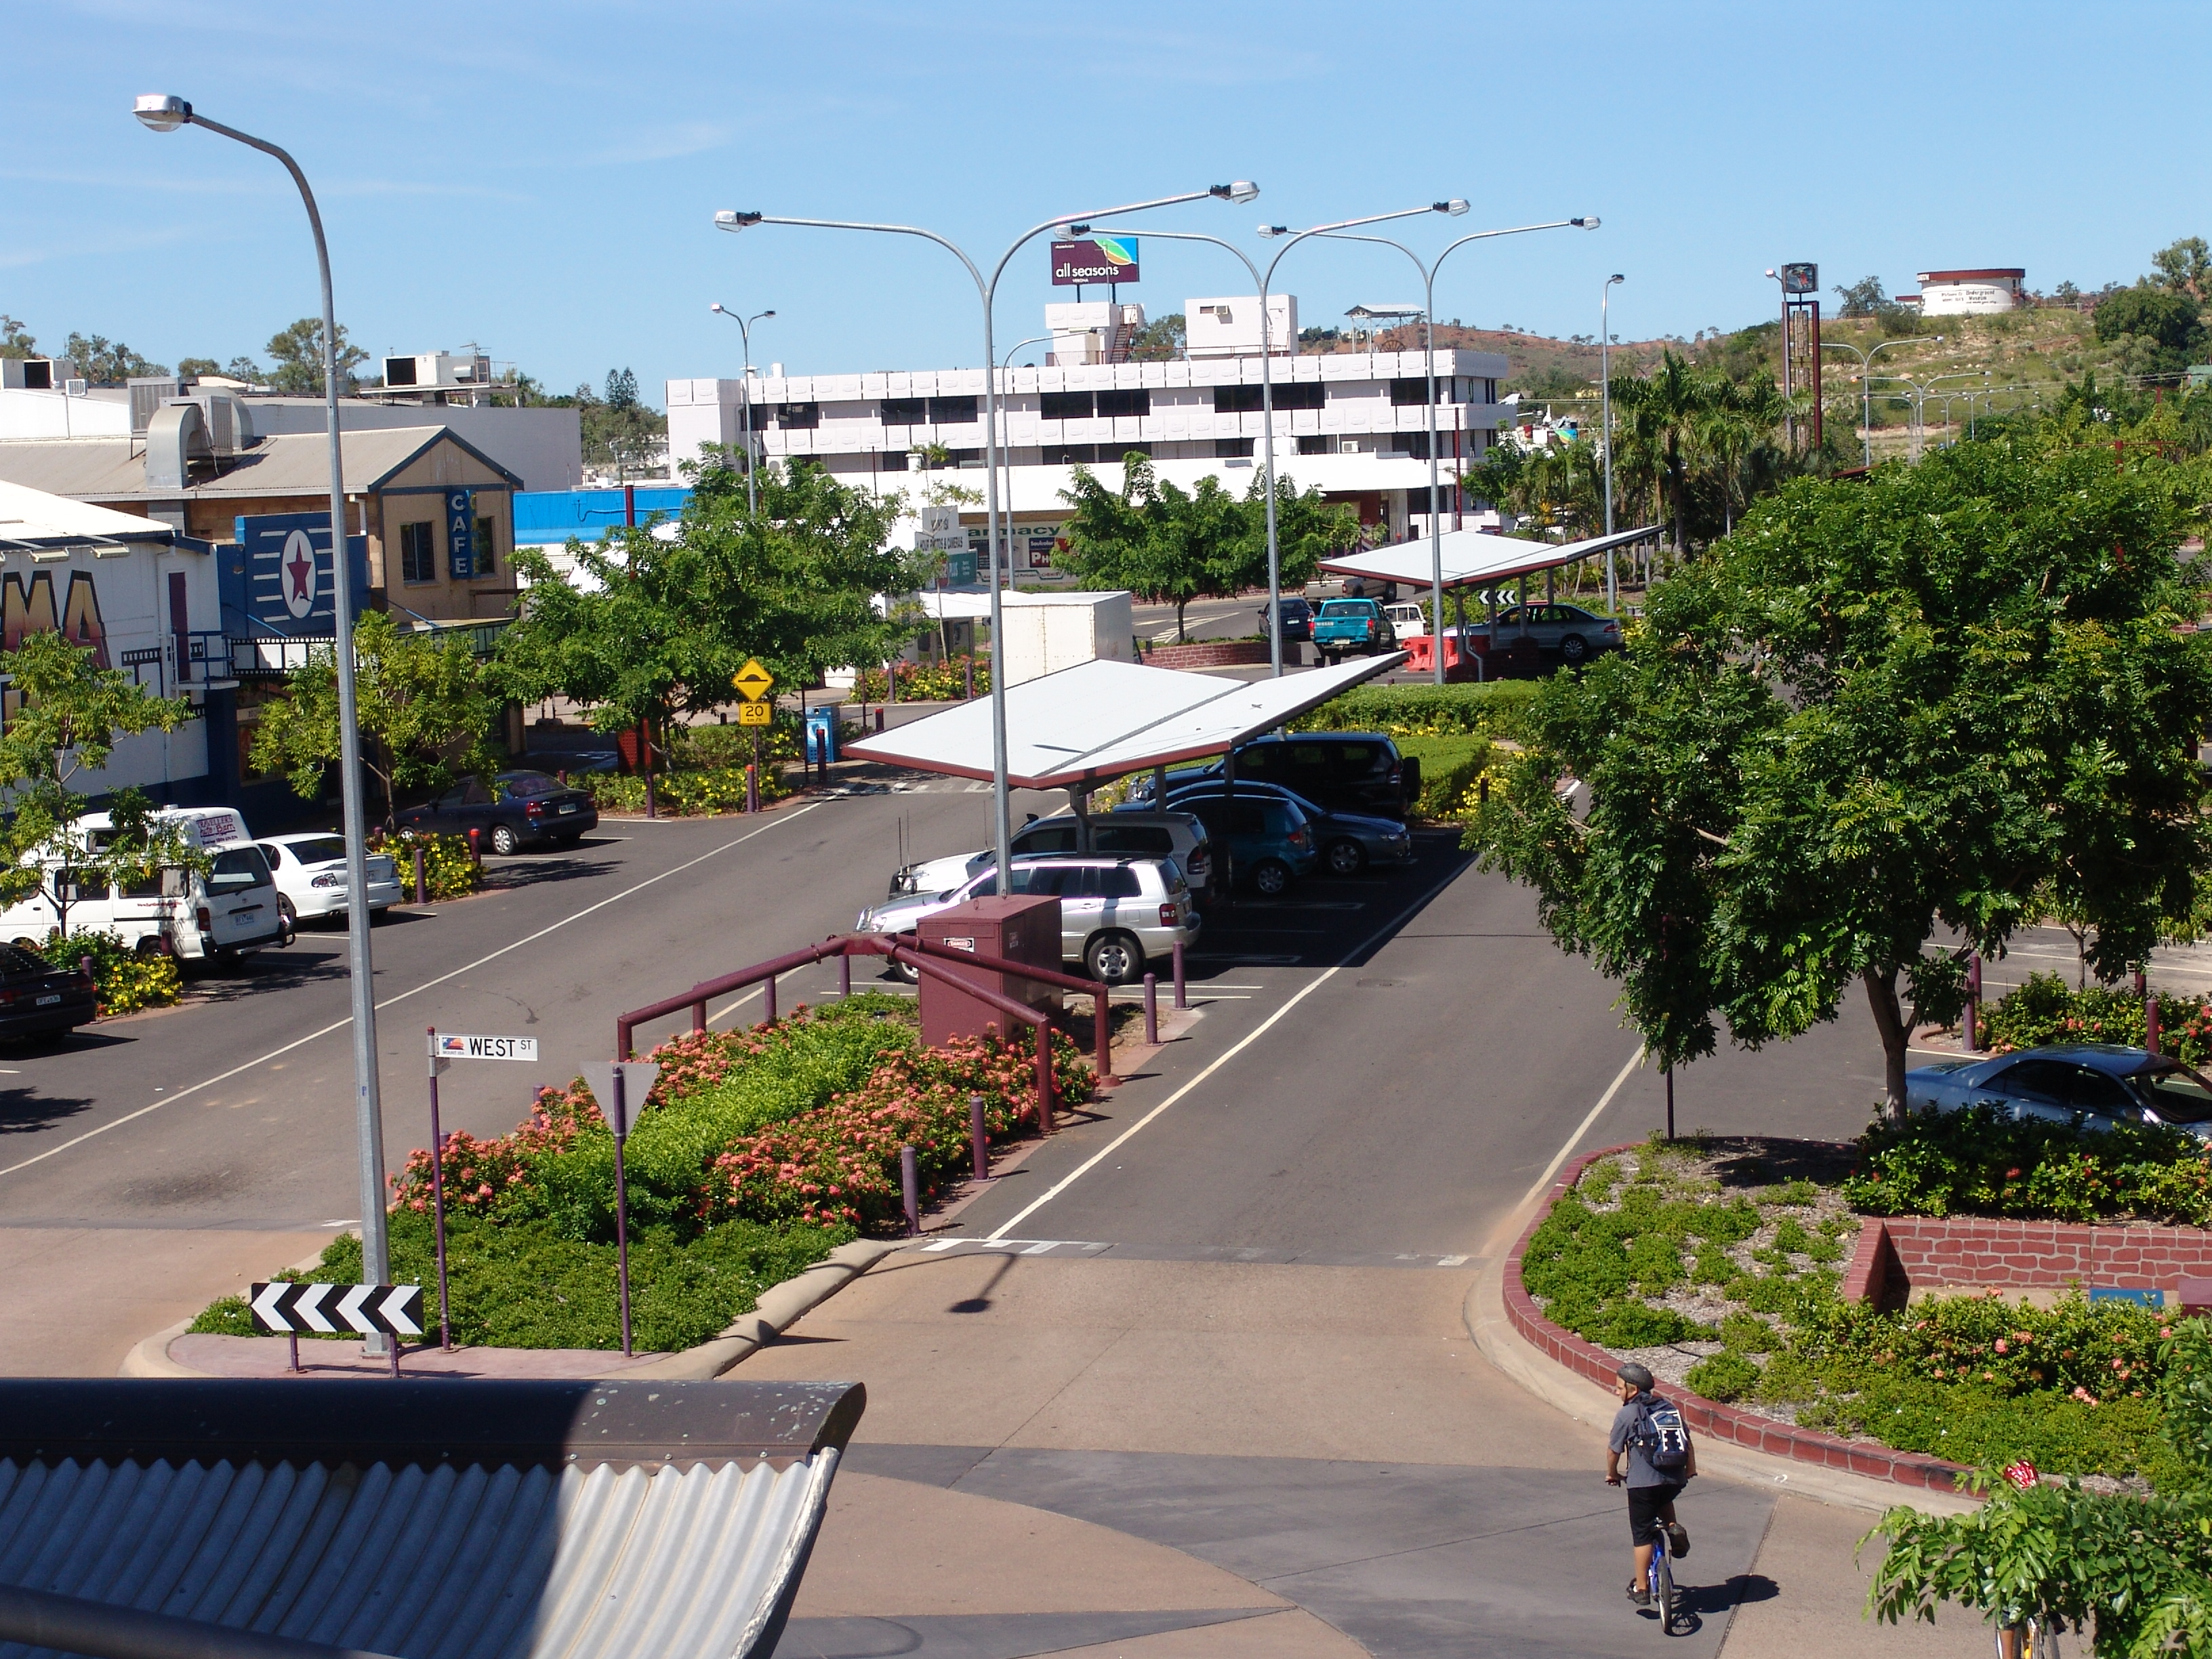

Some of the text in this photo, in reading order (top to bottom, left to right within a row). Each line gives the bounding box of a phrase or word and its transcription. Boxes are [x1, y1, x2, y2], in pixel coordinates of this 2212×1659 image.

[1056, 262, 1120, 278] all seasons
[451, 494, 468, 574] CAFE
[968, 526, 1060, 537] armacy
[1031, 552, 1050, 563] PH
[1, 570, 113, 670] MA
[745, 705, 764, 717] 20
[469, 1038, 532, 1057] WEST ST
